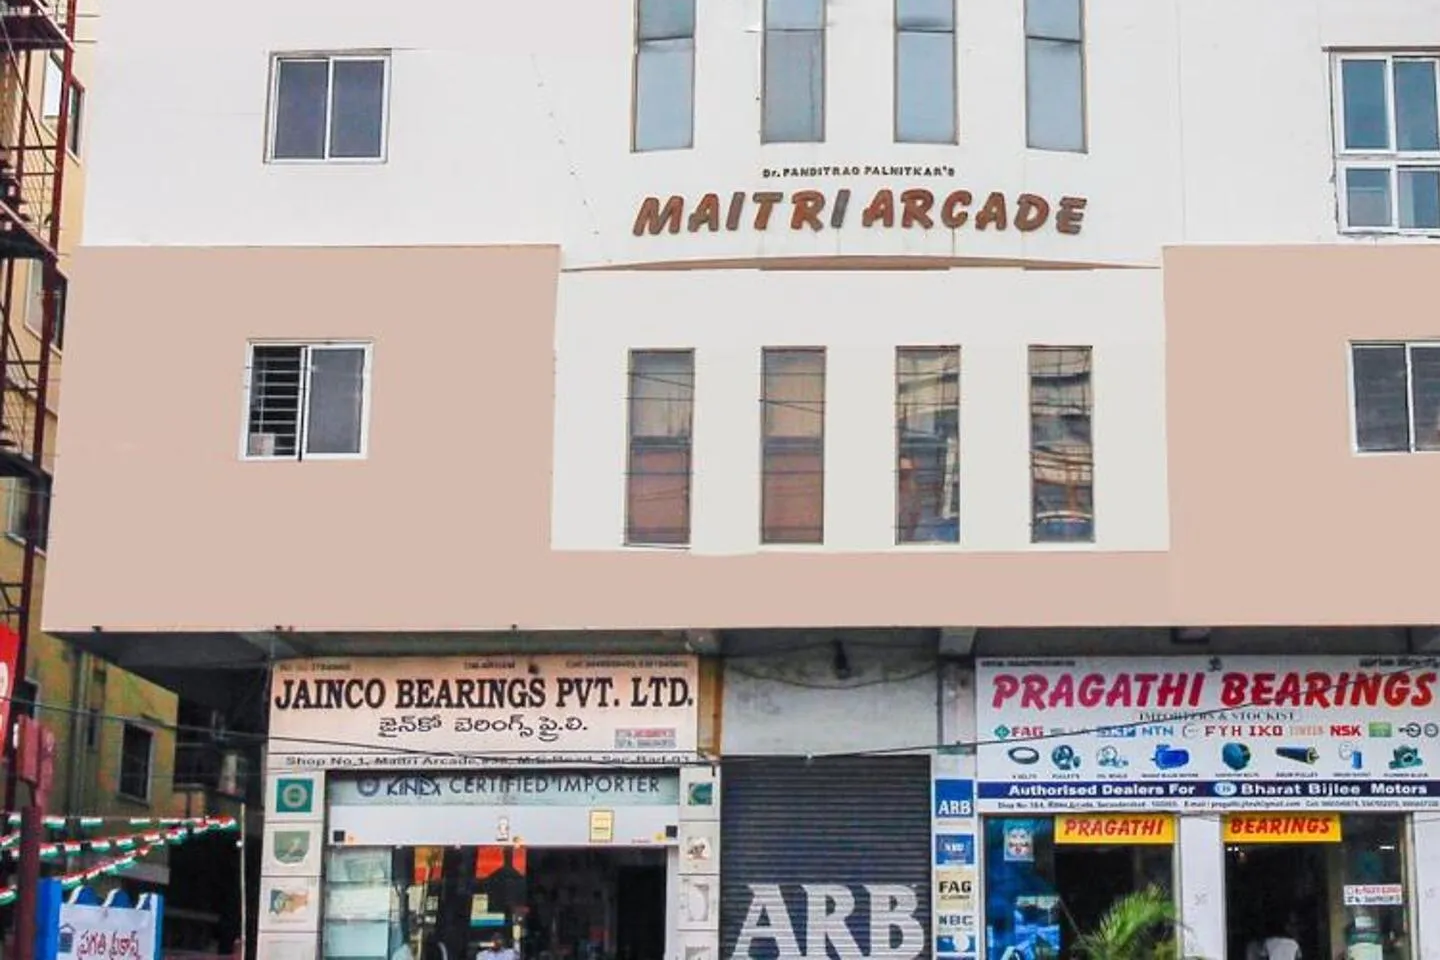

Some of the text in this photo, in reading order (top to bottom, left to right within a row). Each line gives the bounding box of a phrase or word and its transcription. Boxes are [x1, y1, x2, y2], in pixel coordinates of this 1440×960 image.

[783, 166, 860, 177] PANDITRAO
[633, 188, 1088, 237] MAITRI ARCADE
[274, 677, 693, 709] JAINCO BEARINGS PVT. LTD.
[992, 671, 1438, 710] PRAGATHI BEARINGS
[1231, 712, 1294, 721] STOCKIST
[1011, 726, 1044, 737] FAG
[1142, 725, 1174, 736] NTN
[1205, 725, 1242, 736] FYH
[1249, 725, 1284, 736] IKO
[1330, 725, 1362, 736] NSK
[286, 757, 326, 767] Shop
[449, 776, 548, 793] CERTIFIED
[556, 775, 660, 793] IMPORTER
[1009, 783, 1196, 796] Authorised Dealers For
[1241, 783, 1427, 797] Bharat Bijlee Motors
[938, 800, 971, 814] ARB
[1064, 816, 1164, 836] PRAGATHI
[1230, 816, 1331, 835] BEARINGS
[939, 881, 972, 893] FAG
[730, 884, 924, 960] ARB
[938, 915, 974, 926] NBC
